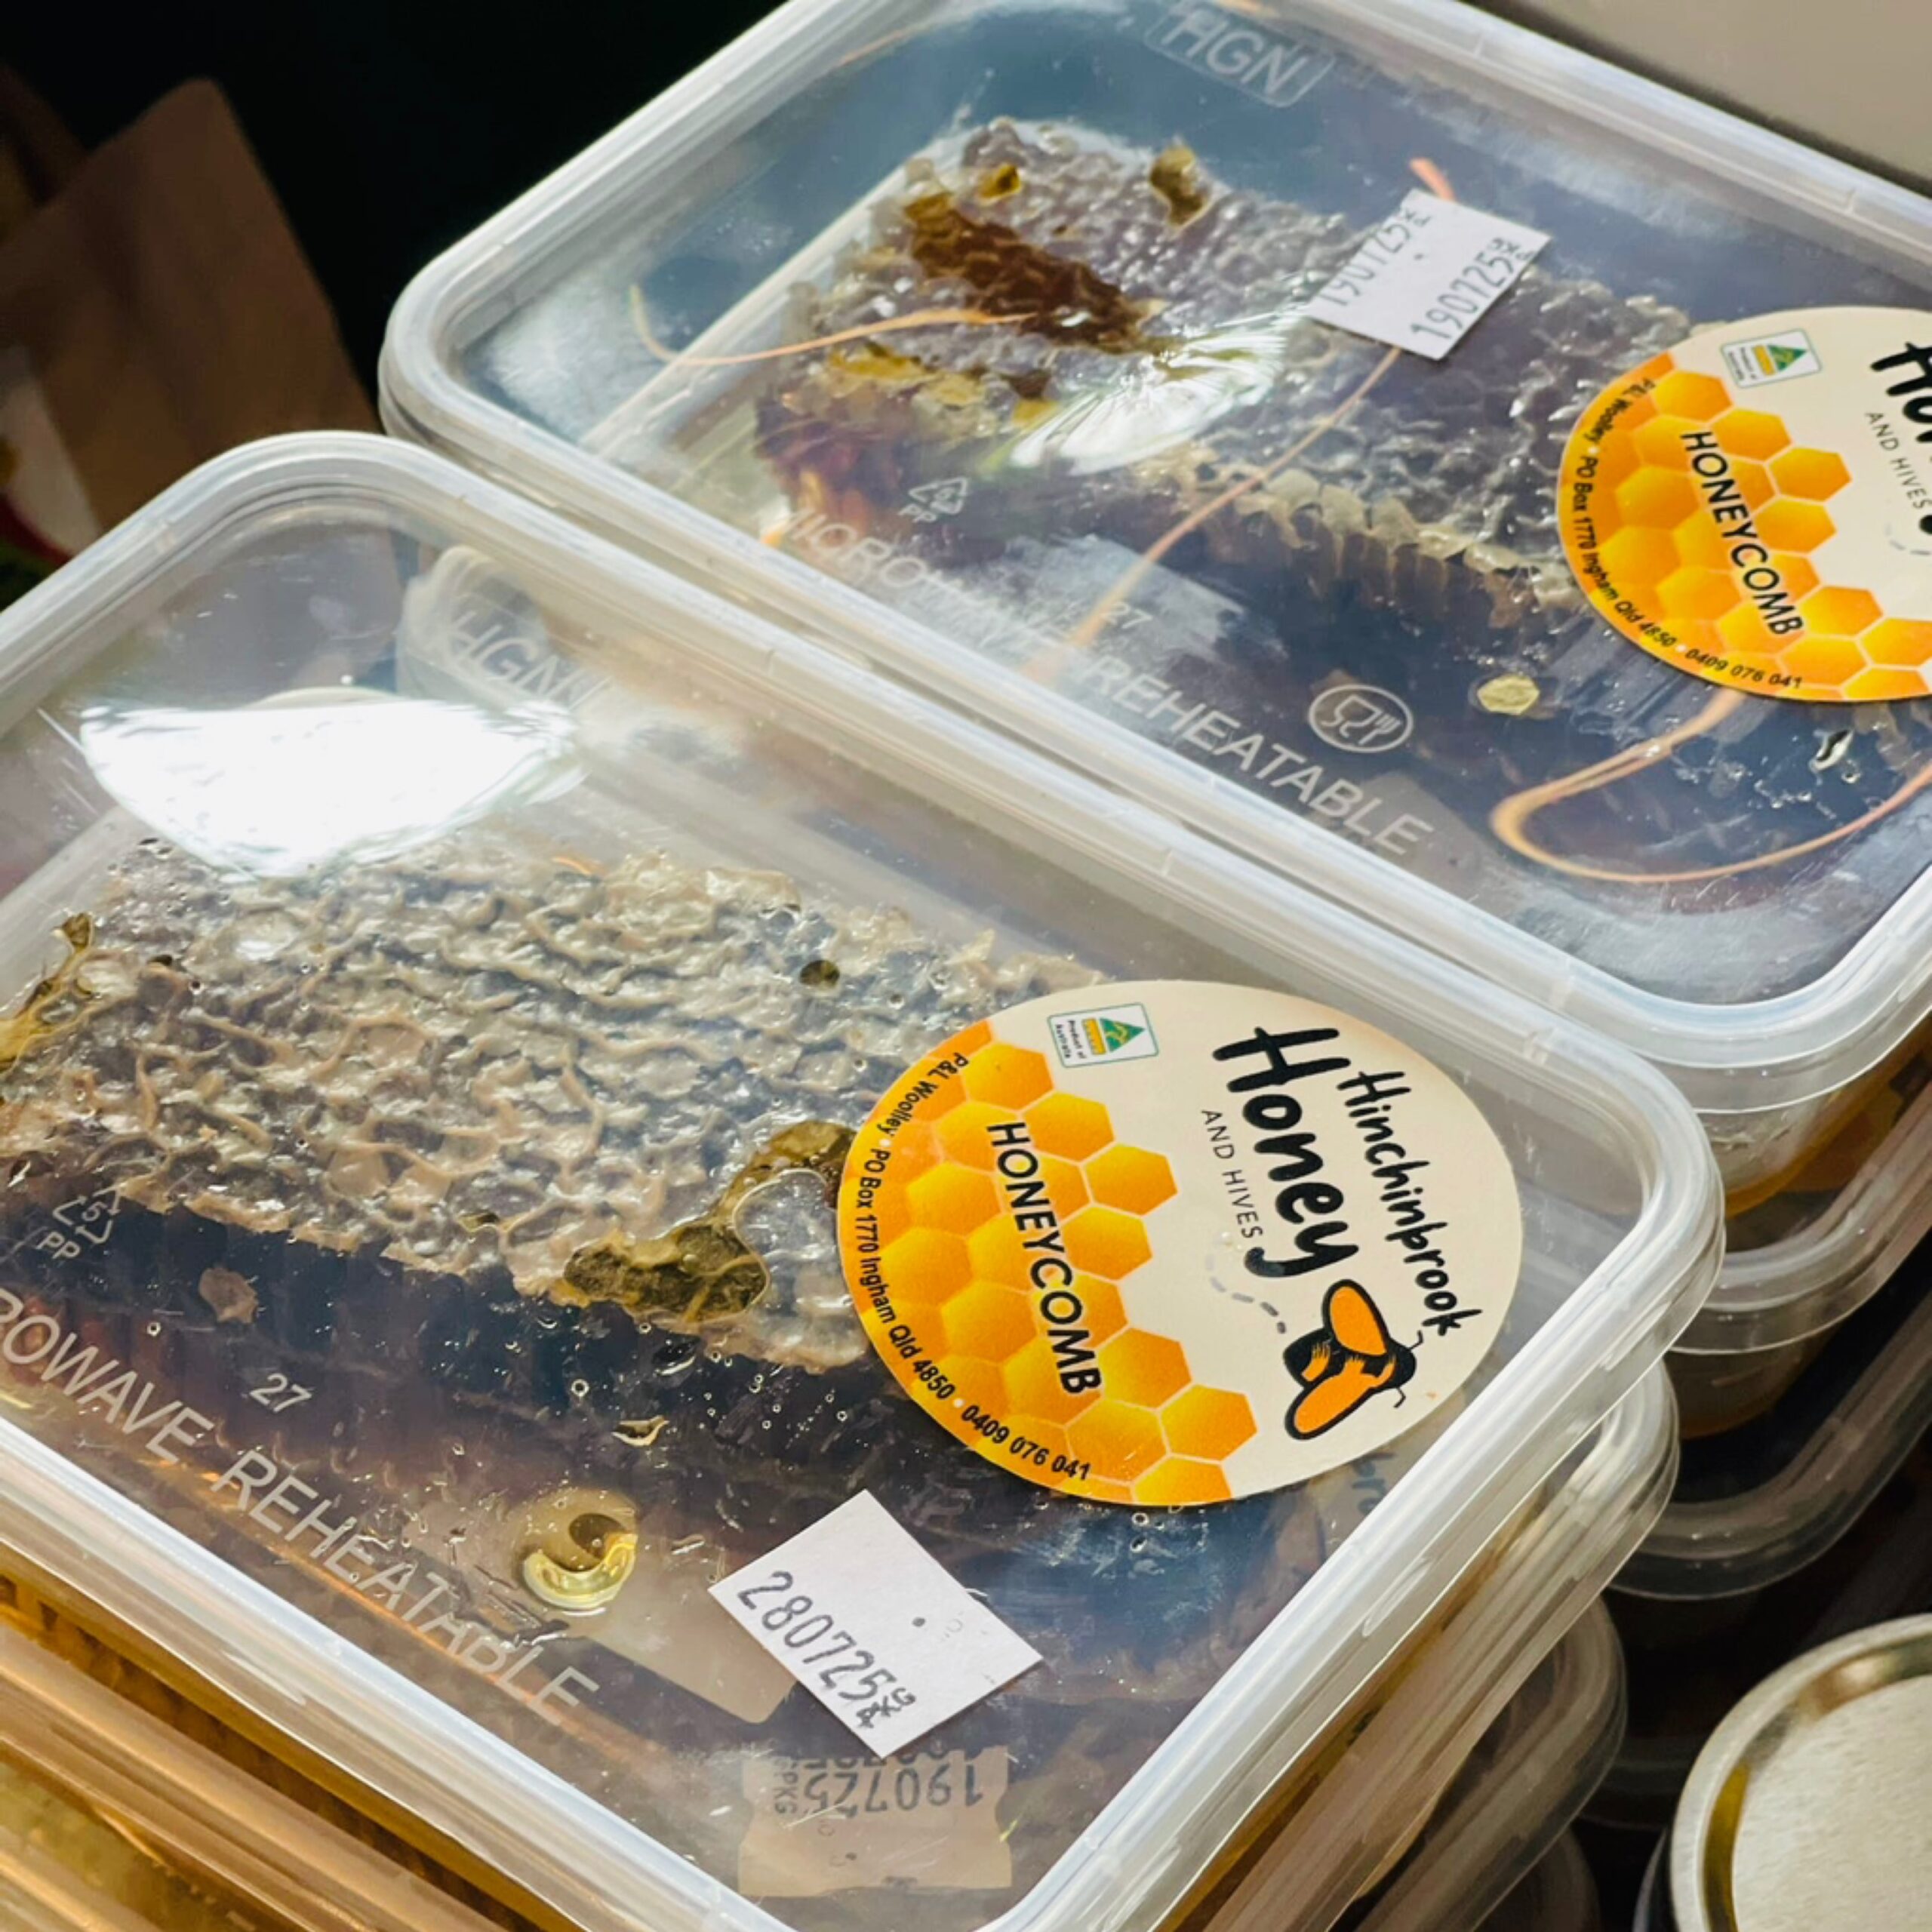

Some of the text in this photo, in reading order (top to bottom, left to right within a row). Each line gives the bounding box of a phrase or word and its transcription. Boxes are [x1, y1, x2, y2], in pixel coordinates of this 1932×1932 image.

[1160, 9, 1309, 94] HGN
[1410, 251, 1514, 340] 190725
[1865, 412, 1900, 451] AND
[1577, 456, 1598, 478] PO
[899, 503, 937, 523] PP
[1573, 482, 1593, 512] Box
[1680, 431, 1803, 635] HONEYCOMB
[1583, 552, 1619, 601] Ingham
[1099, 603, 1153, 631] 27
[1614, 601, 1644, 623] Qld
[1685, 648, 1728, 671] 0409
[1730, 663, 1766, 682] 076
[1767, 673, 1803, 689] 041
[1084, 656, 1433, 855] REHEATABLE
[1201, 1109, 1263, 1238] AND HIVES
[1212, 1026, 1358, 1278] Honey
[1337, 1071, 1482, 1336] Hinchinbrook
[35, 1231, 81, 1259] PP
[855, 1052, 1091, 1480] P&L Woolley PO Box 1770 Ingham Qld 4850 0409 076 041
[986, 1121, 1102, 1394] HONEYCOMB
[249, 1372, 312, 1413] 27
[210, 1450, 600, 1727] REHEATABLE
[737, 1571, 897, 1701] 280725
[804, 1764, 983, 1819] 190725
